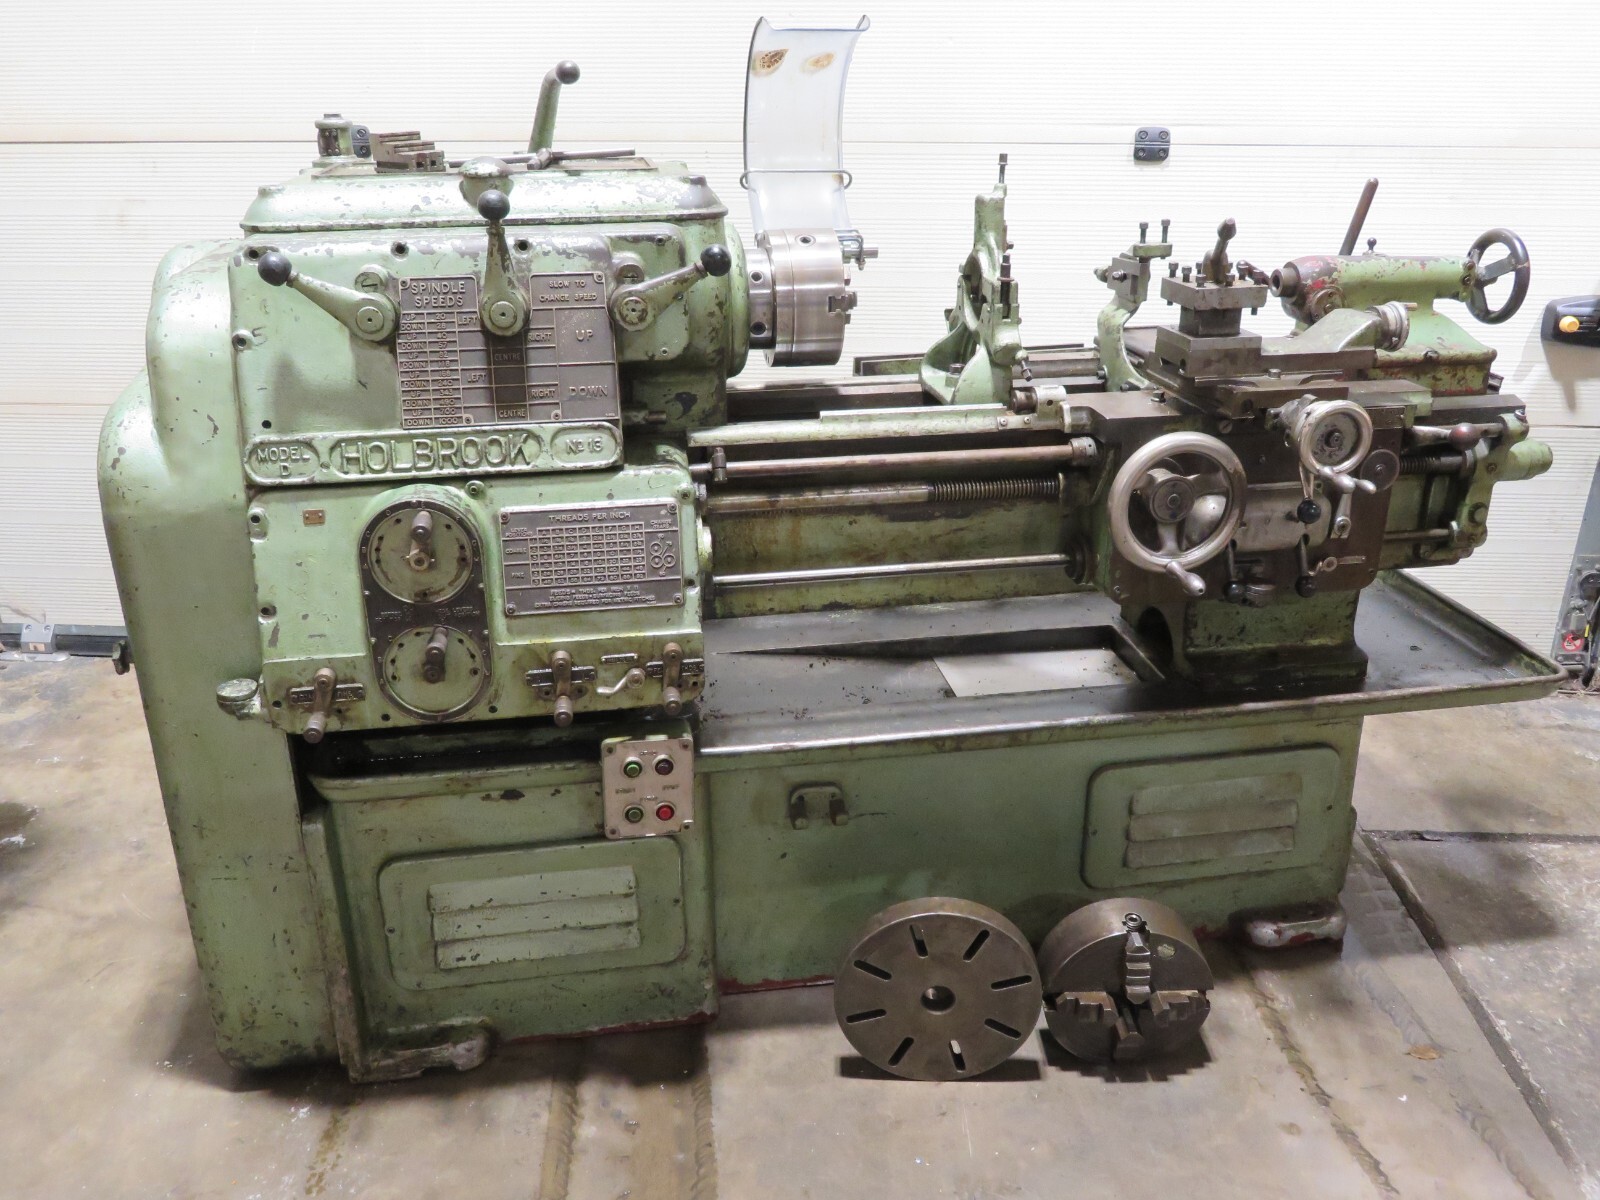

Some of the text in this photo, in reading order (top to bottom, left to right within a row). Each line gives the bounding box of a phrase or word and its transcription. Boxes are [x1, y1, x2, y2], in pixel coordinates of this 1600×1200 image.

[411, 282, 465, 294] SPINDLE
[549, 280, 570, 288] SLOW
[415, 296, 463, 307] SPEEDS
[540, 293, 597, 302] CHANGE SPEED
[458, 316, 478, 325] LEFT
[528, 333, 552, 342] RIGHT
[576, 329, 593, 341] UP
[467, 373, 486, 382] LEFT
[531, 389, 556, 399] RIGHT
[569, 386, 608, 397] DOWN
[499, 409, 526, 418] CENTRE
[257, 447, 310, 463] MODEL
[340, 433, 531, 474] HOLBROOK
[280, 463, 290, 478] D
[549, 512, 630, 523] THREADS PER INCH
